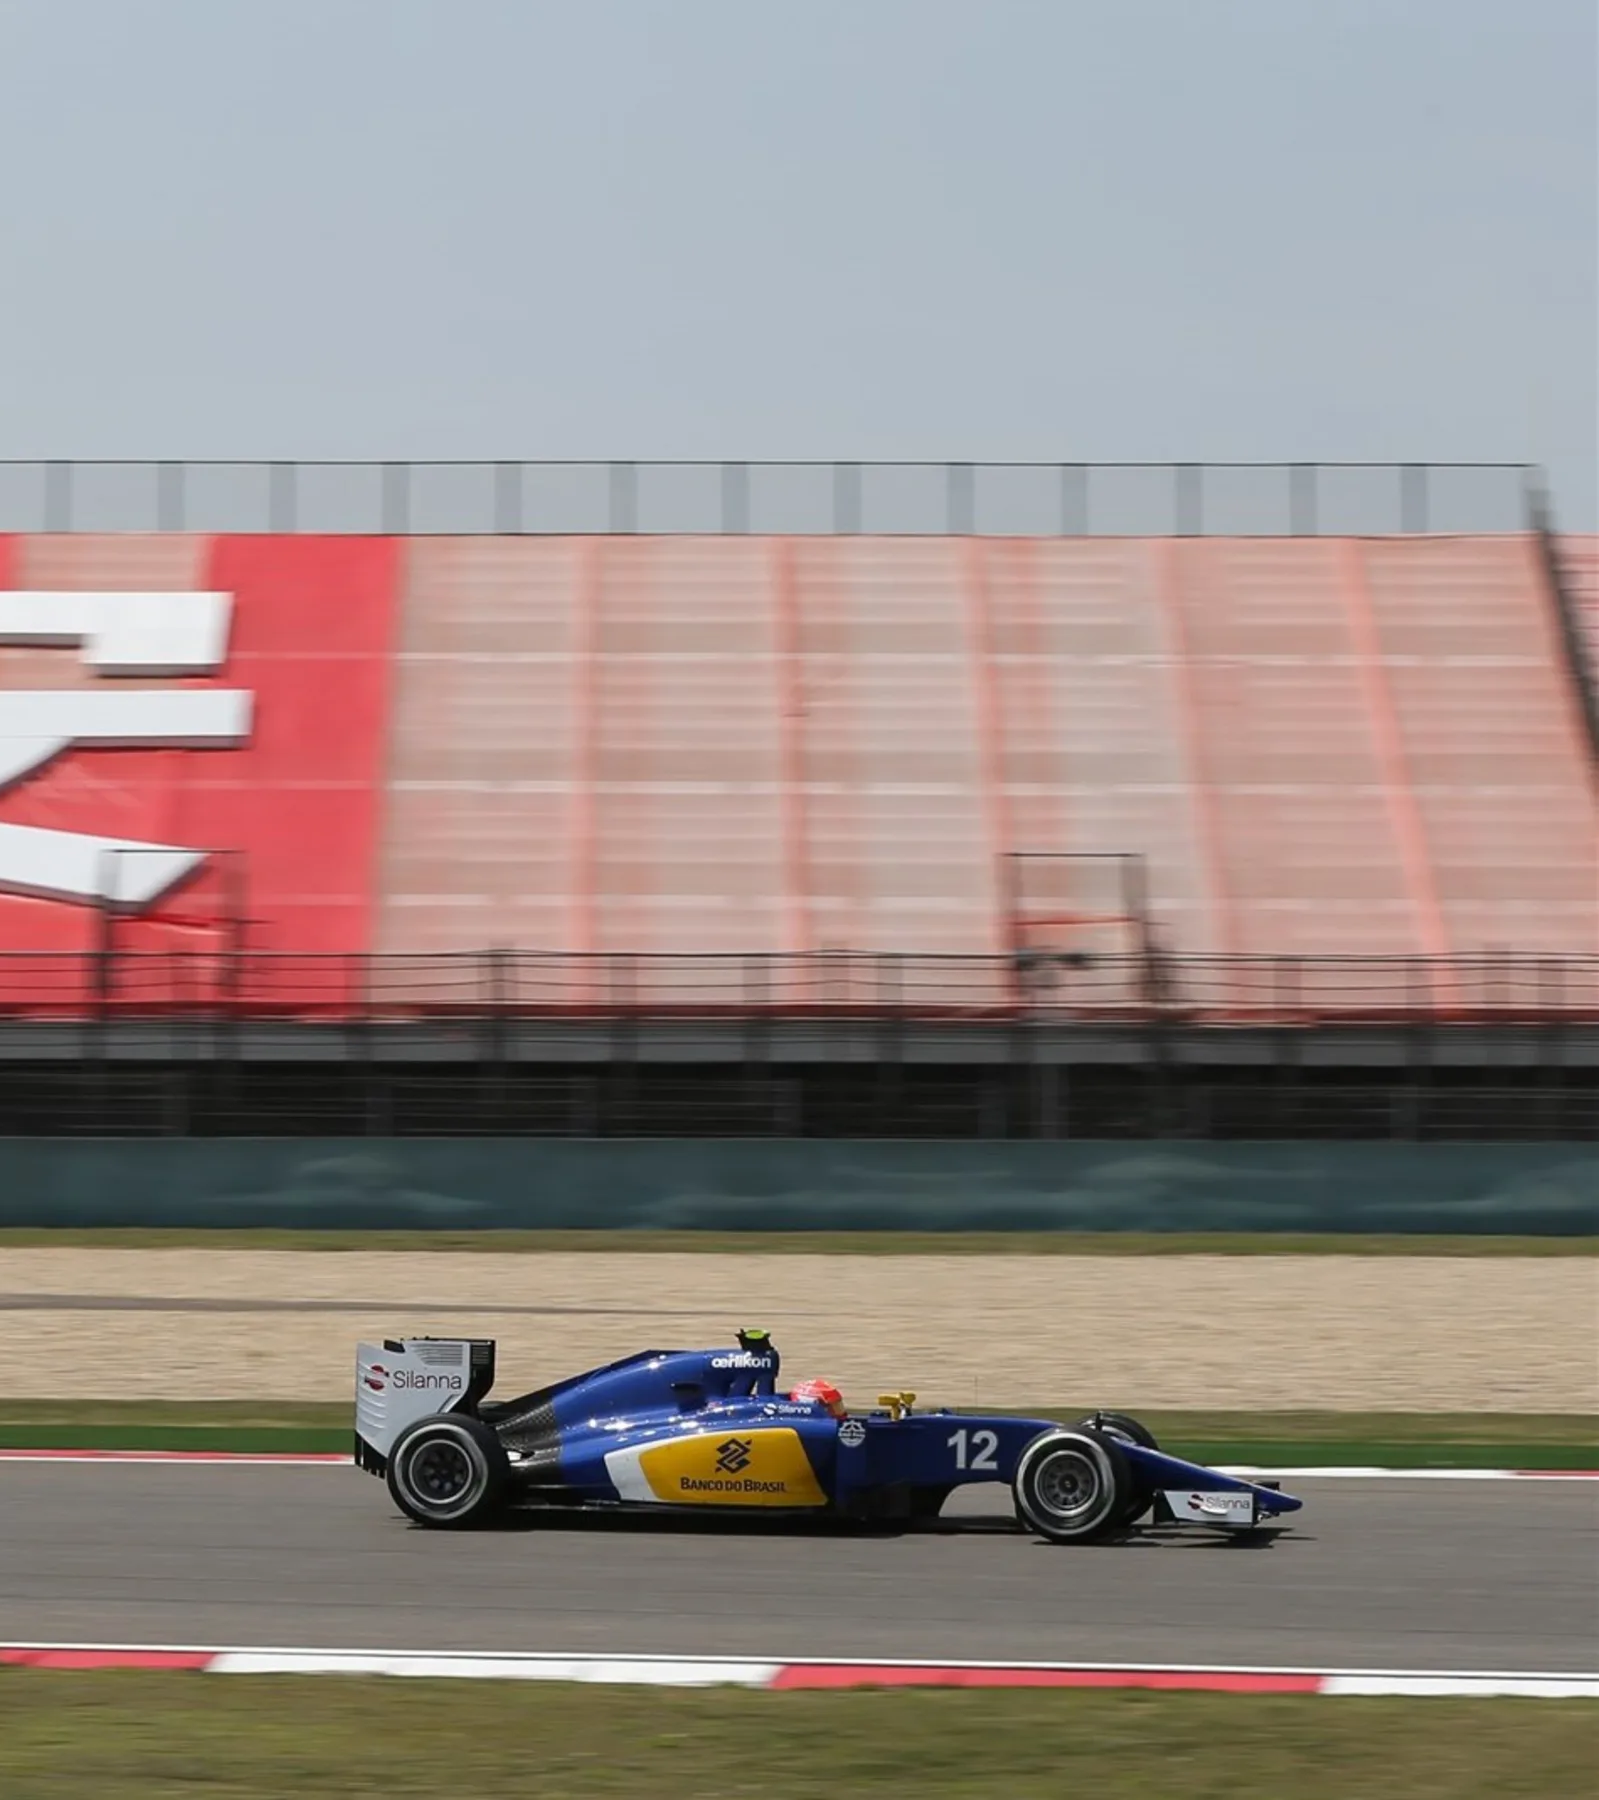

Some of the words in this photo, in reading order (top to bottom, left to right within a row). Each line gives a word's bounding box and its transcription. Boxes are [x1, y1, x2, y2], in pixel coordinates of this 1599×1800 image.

[392, 1370, 462, 1389] Silanna
[947, 1429, 998, 1470] 12
[680, 1477, 723, 1491] BANCO
[725, 1480, 741, 1491] DO
[743, 1479, 786, 1493] BRASIL
